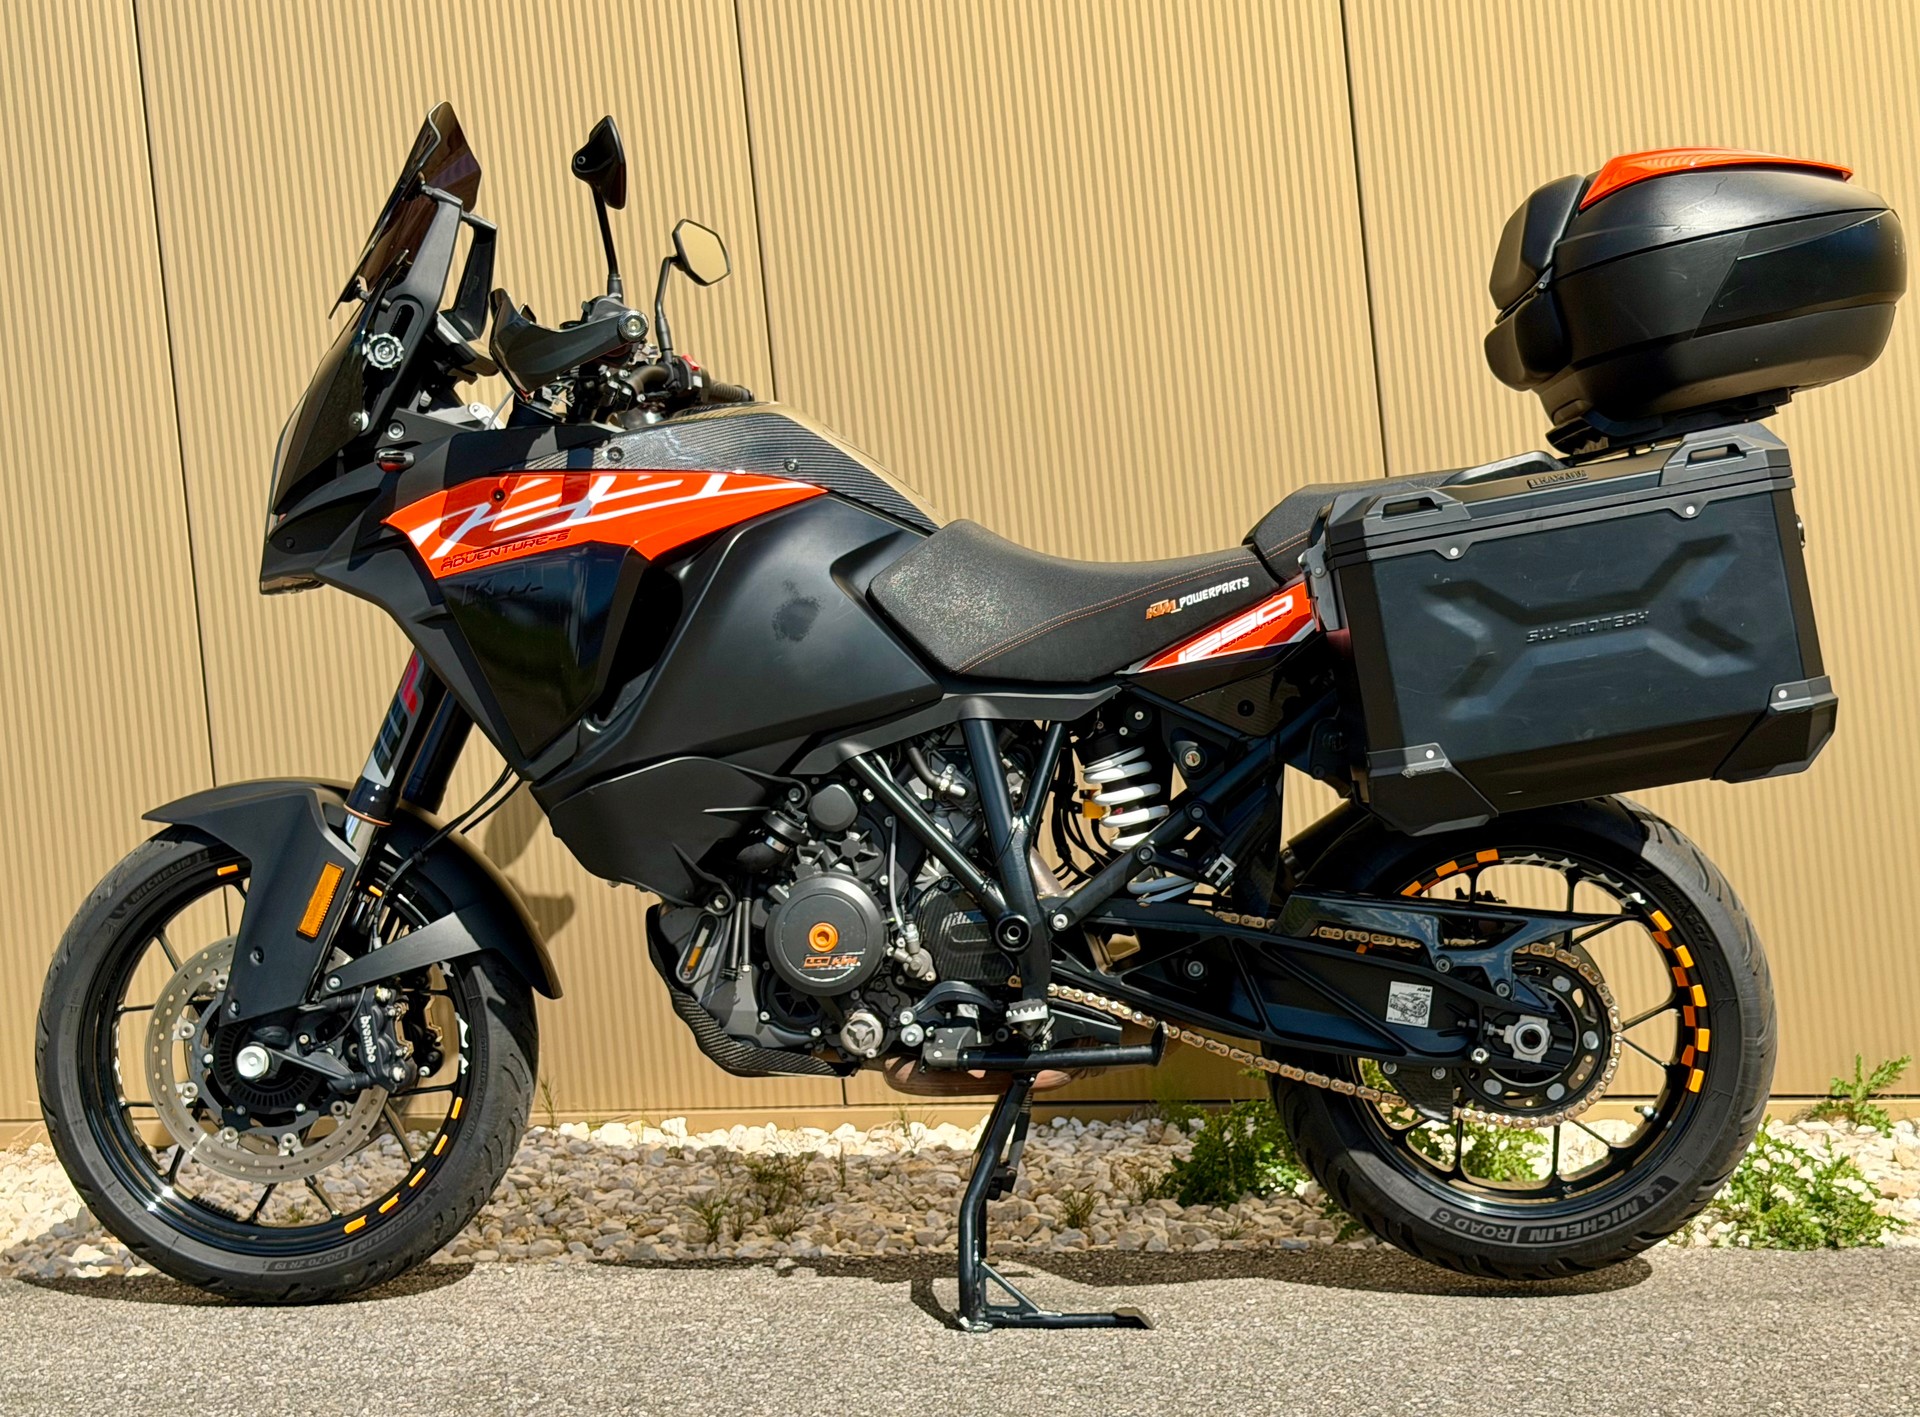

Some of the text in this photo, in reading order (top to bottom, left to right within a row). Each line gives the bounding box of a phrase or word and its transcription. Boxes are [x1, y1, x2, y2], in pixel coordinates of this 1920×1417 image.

[1146, 576, 1250, 620] KTM POWERPARTS
[1178, 595, 1293, 664] 1290
[132, 856, 192, 903] MICHELIN
[359, 1014, 377, 1063] brembo
[1436, 1202, 1640, 1243] MICHELIN ROAD 6
